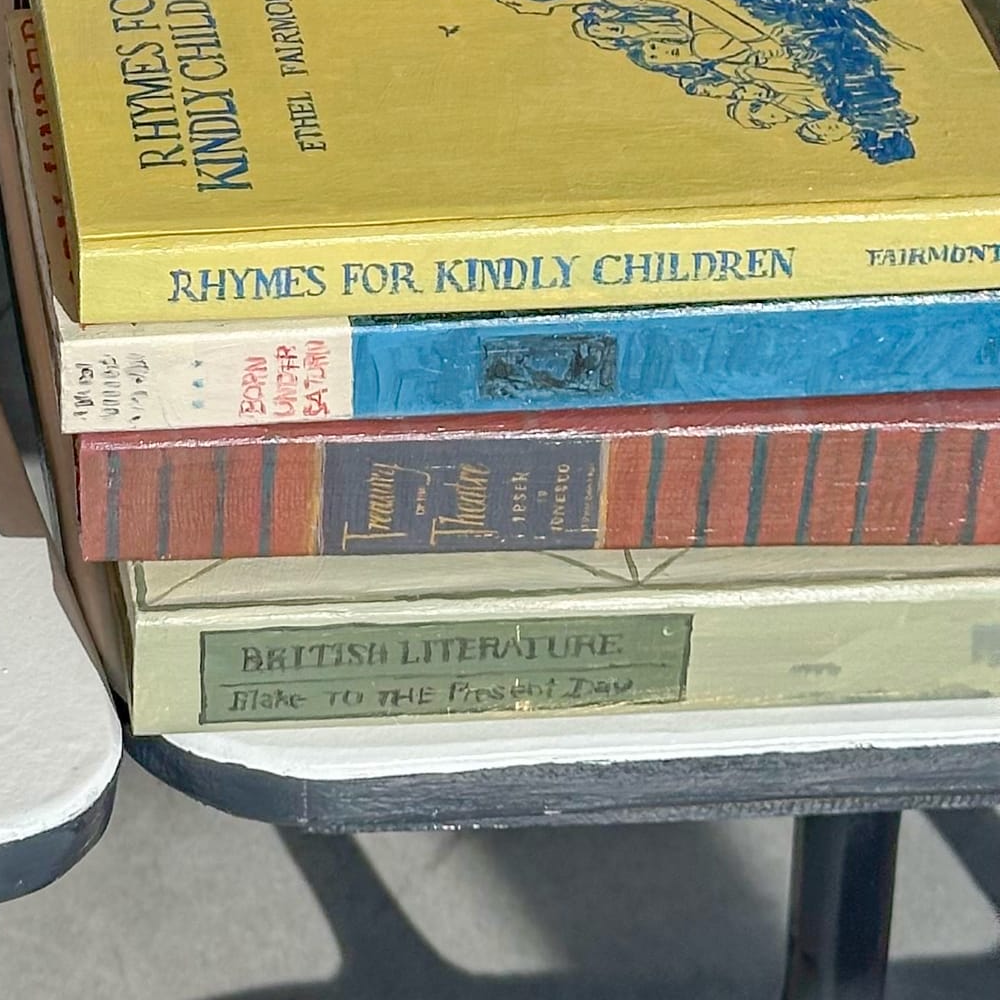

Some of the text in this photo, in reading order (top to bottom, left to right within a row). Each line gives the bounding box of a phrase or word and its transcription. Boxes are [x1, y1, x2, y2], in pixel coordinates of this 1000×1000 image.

[115, 40, 189, 170] RHYMES
[286, 90, 328, 153] ETHEL
[180, 86, 254, 194] KINDLY
[167, 243, 1000, 303] RHYMES FOR KINDLY CHILDREN FAIRMONT
[239, 356, 269, 420] BORN
[240, 632, 626, 674] BRITISH LITERATURE
